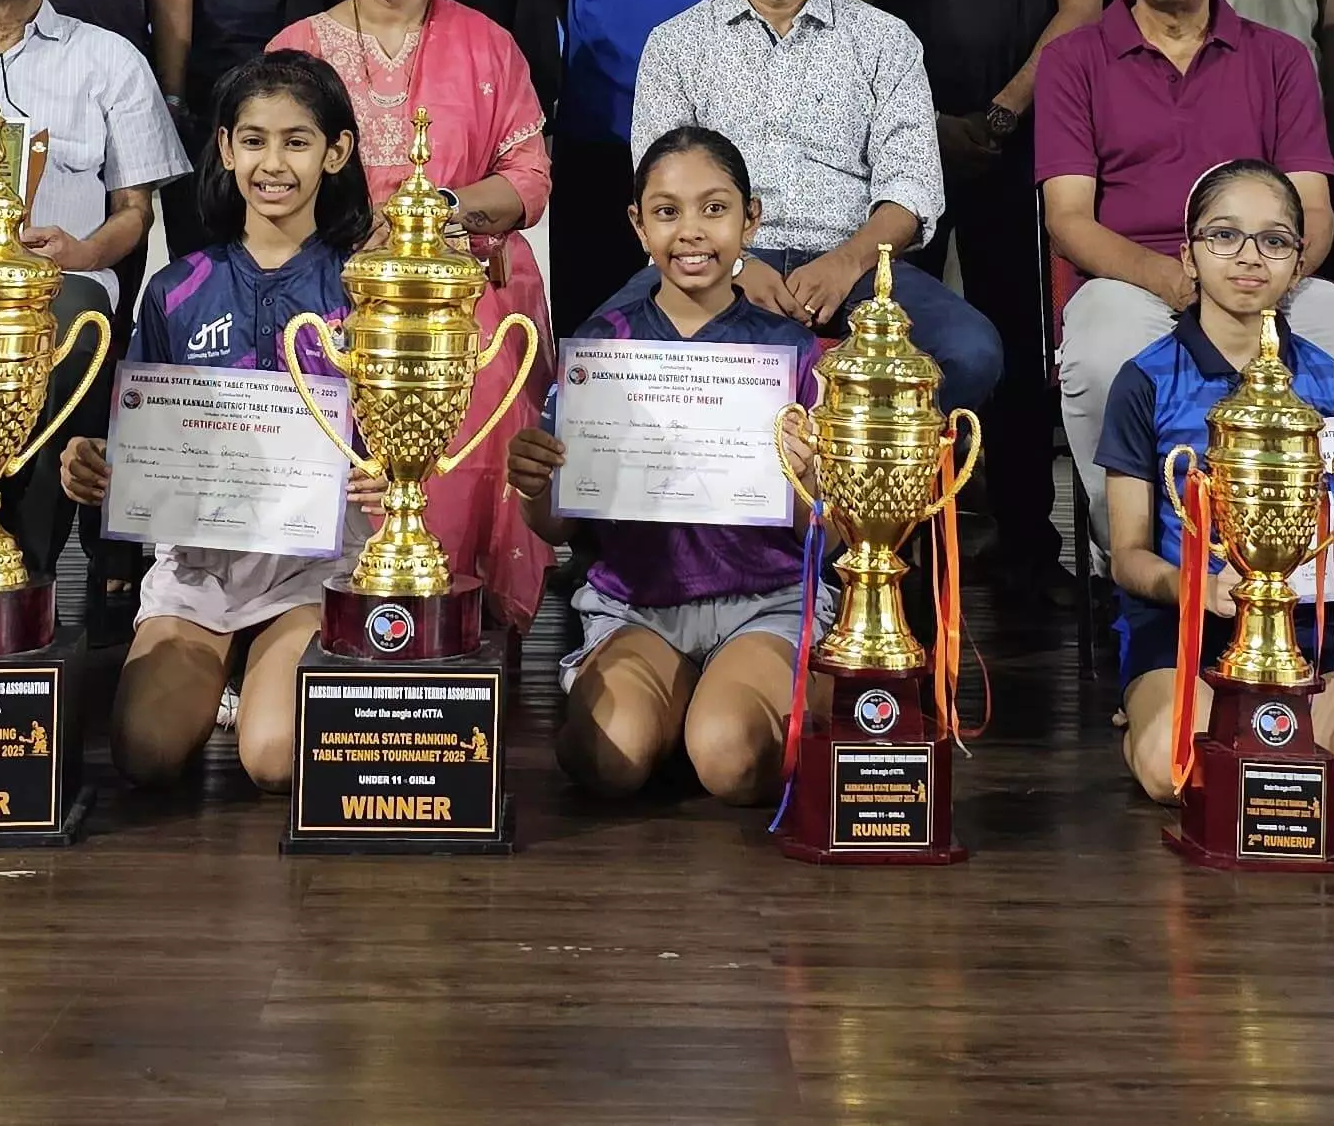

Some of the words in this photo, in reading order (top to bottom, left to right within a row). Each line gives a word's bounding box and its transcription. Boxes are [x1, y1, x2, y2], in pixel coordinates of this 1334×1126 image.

[627, 393, 681, 403] CERTIFICATE
[684, 395, 695, 403] OF
[697, 395, 723, 405] MERIT
[182, 419, 237, 431] CERTIFICATE
[240, 422, 251, 431] OF
[254, 423, 281, 434] MERIT
[6, 682, 49, 694] ASSOCIATION
[447, 688, 490, 701] ASSOCIATION
[355, 708, 377, 718] Under
[422, 709, 443, 718] KTTA
[321, 732, 379, 745] KARNATAKA
[381, 732, 412, 745] STATE
[415, 733, 457, 745] RANKING
[2, 745, 24, 757] 2025
[313, 749, 343, 761] TABLE
[345, 750, 380, 761] TENNIS
[382, 750, 441, 762] TOURNAMET
[443, 751, 465, 762] 2025
[359, 775, 389, 784] UNDER
[391, 775, 402, 784] 11
[409, 776, 435, 785] GIRLS
[342, 796, 451, 820] WINNER
[852, 824, 911, 837] RUNNER
[1264, 835, 1315, 848] RUNNERUP
